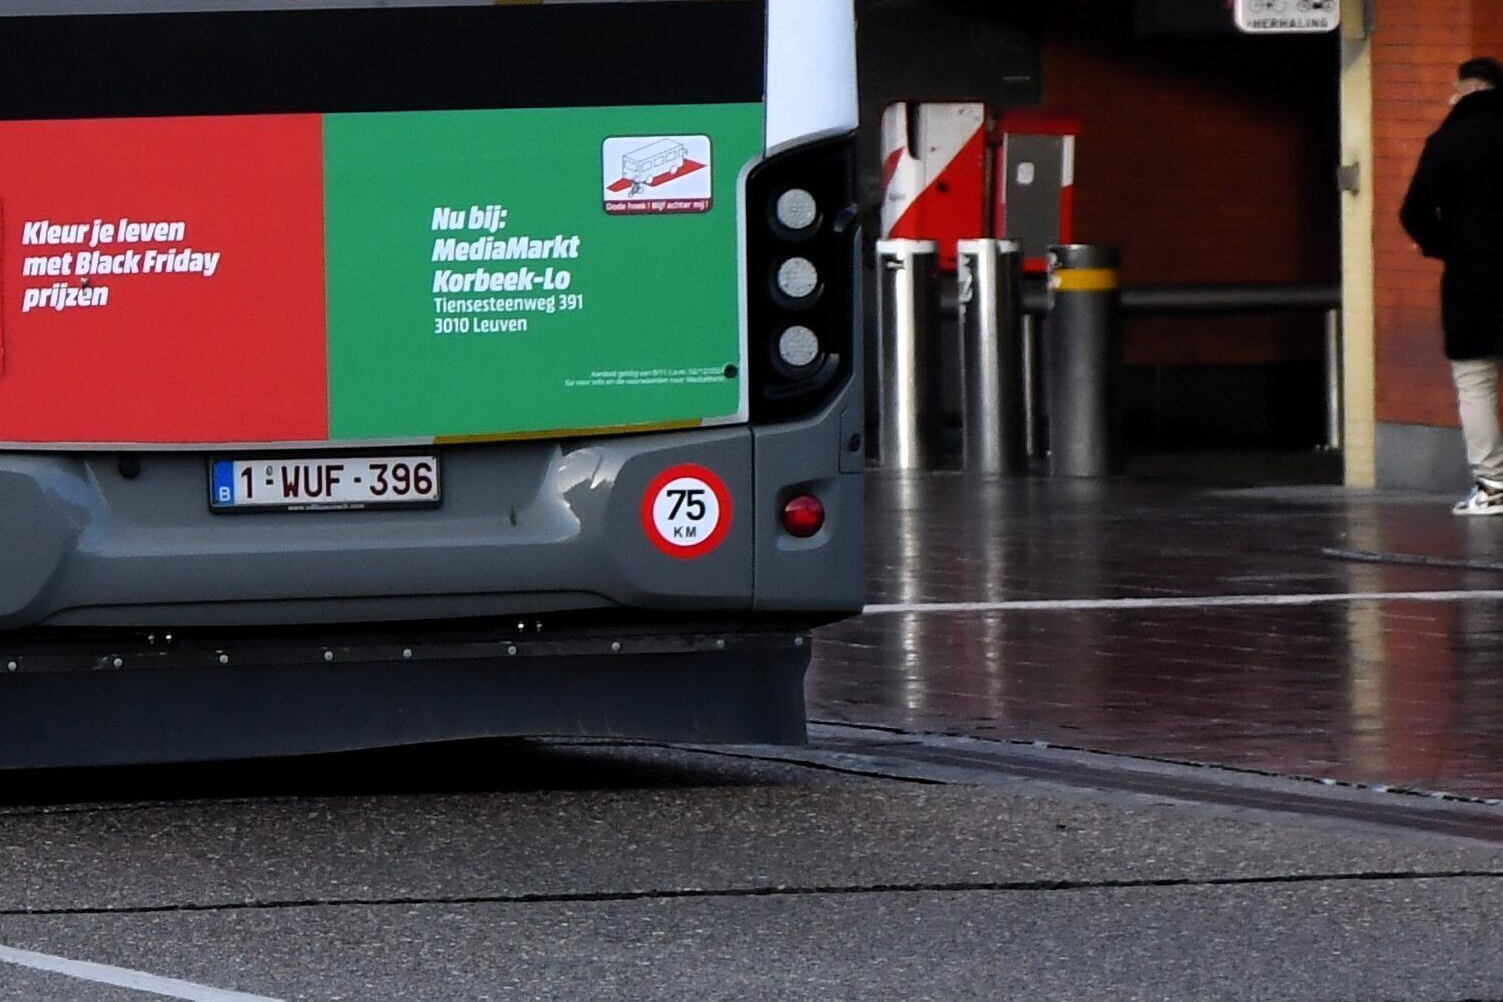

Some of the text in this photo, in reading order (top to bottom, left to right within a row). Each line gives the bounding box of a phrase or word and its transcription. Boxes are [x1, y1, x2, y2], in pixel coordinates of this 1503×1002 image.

[22, 218, 186, 248] Kleur je leven
[431, 205, 508, 234] Nu bij:
[431, 234, 581, 262] MediaMarkt
[22, 248, 221, 277] met Black Friday
[432, 266, 571, 293] Korbeek-Lo
[22, 282, 109, 313] prijzen
[433, 294, 584, 314] Tiensesteenweg 391
[434, 317, 528, 334] 3010 Leuven
[218, 485, 231, 502] B
[666, 489, 706, 521] 75
[673, 526, 697, 538] KM
